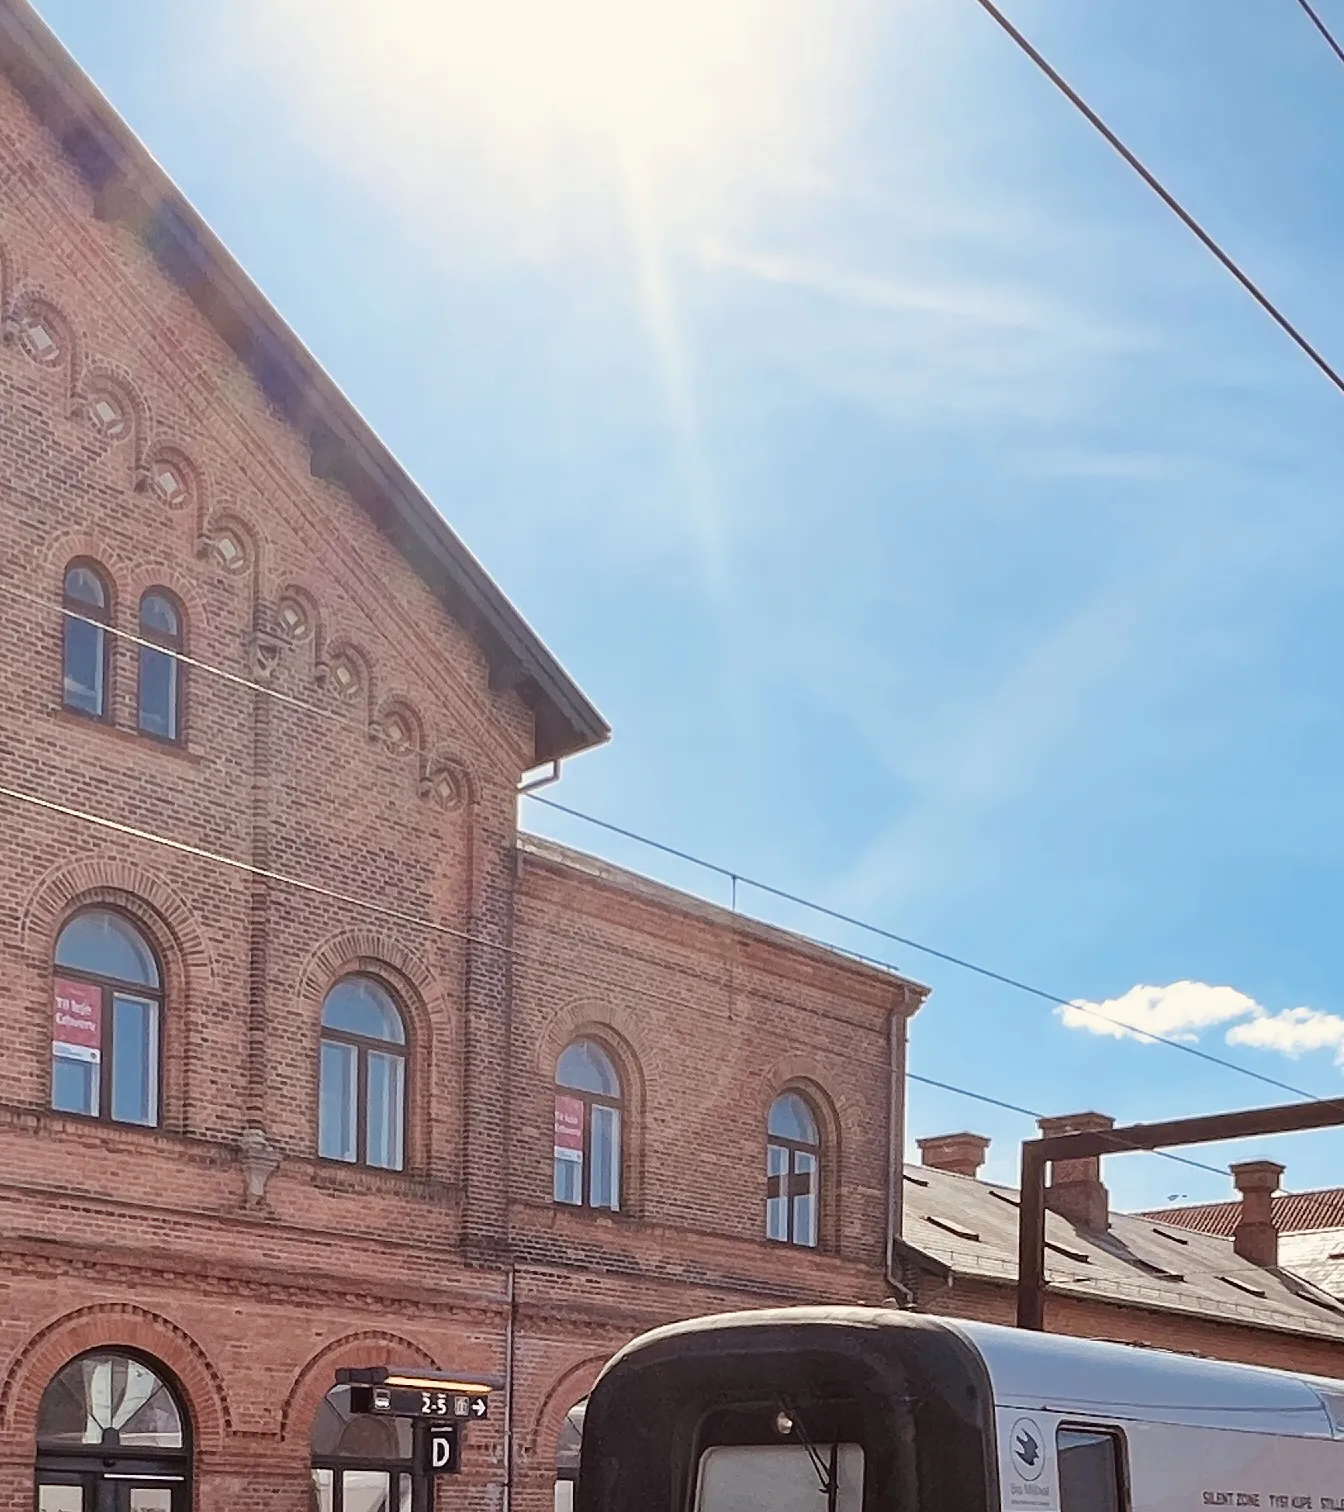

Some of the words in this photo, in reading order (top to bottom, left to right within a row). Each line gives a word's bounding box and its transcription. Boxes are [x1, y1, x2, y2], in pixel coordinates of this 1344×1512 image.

[421, 1395, 447, 1415] 2-5
[432, 1437, 450, 1467] D
[1202, 1491, 1234, 1506] SILENT
[1236, 1492, 1260, 1508] ZONE
